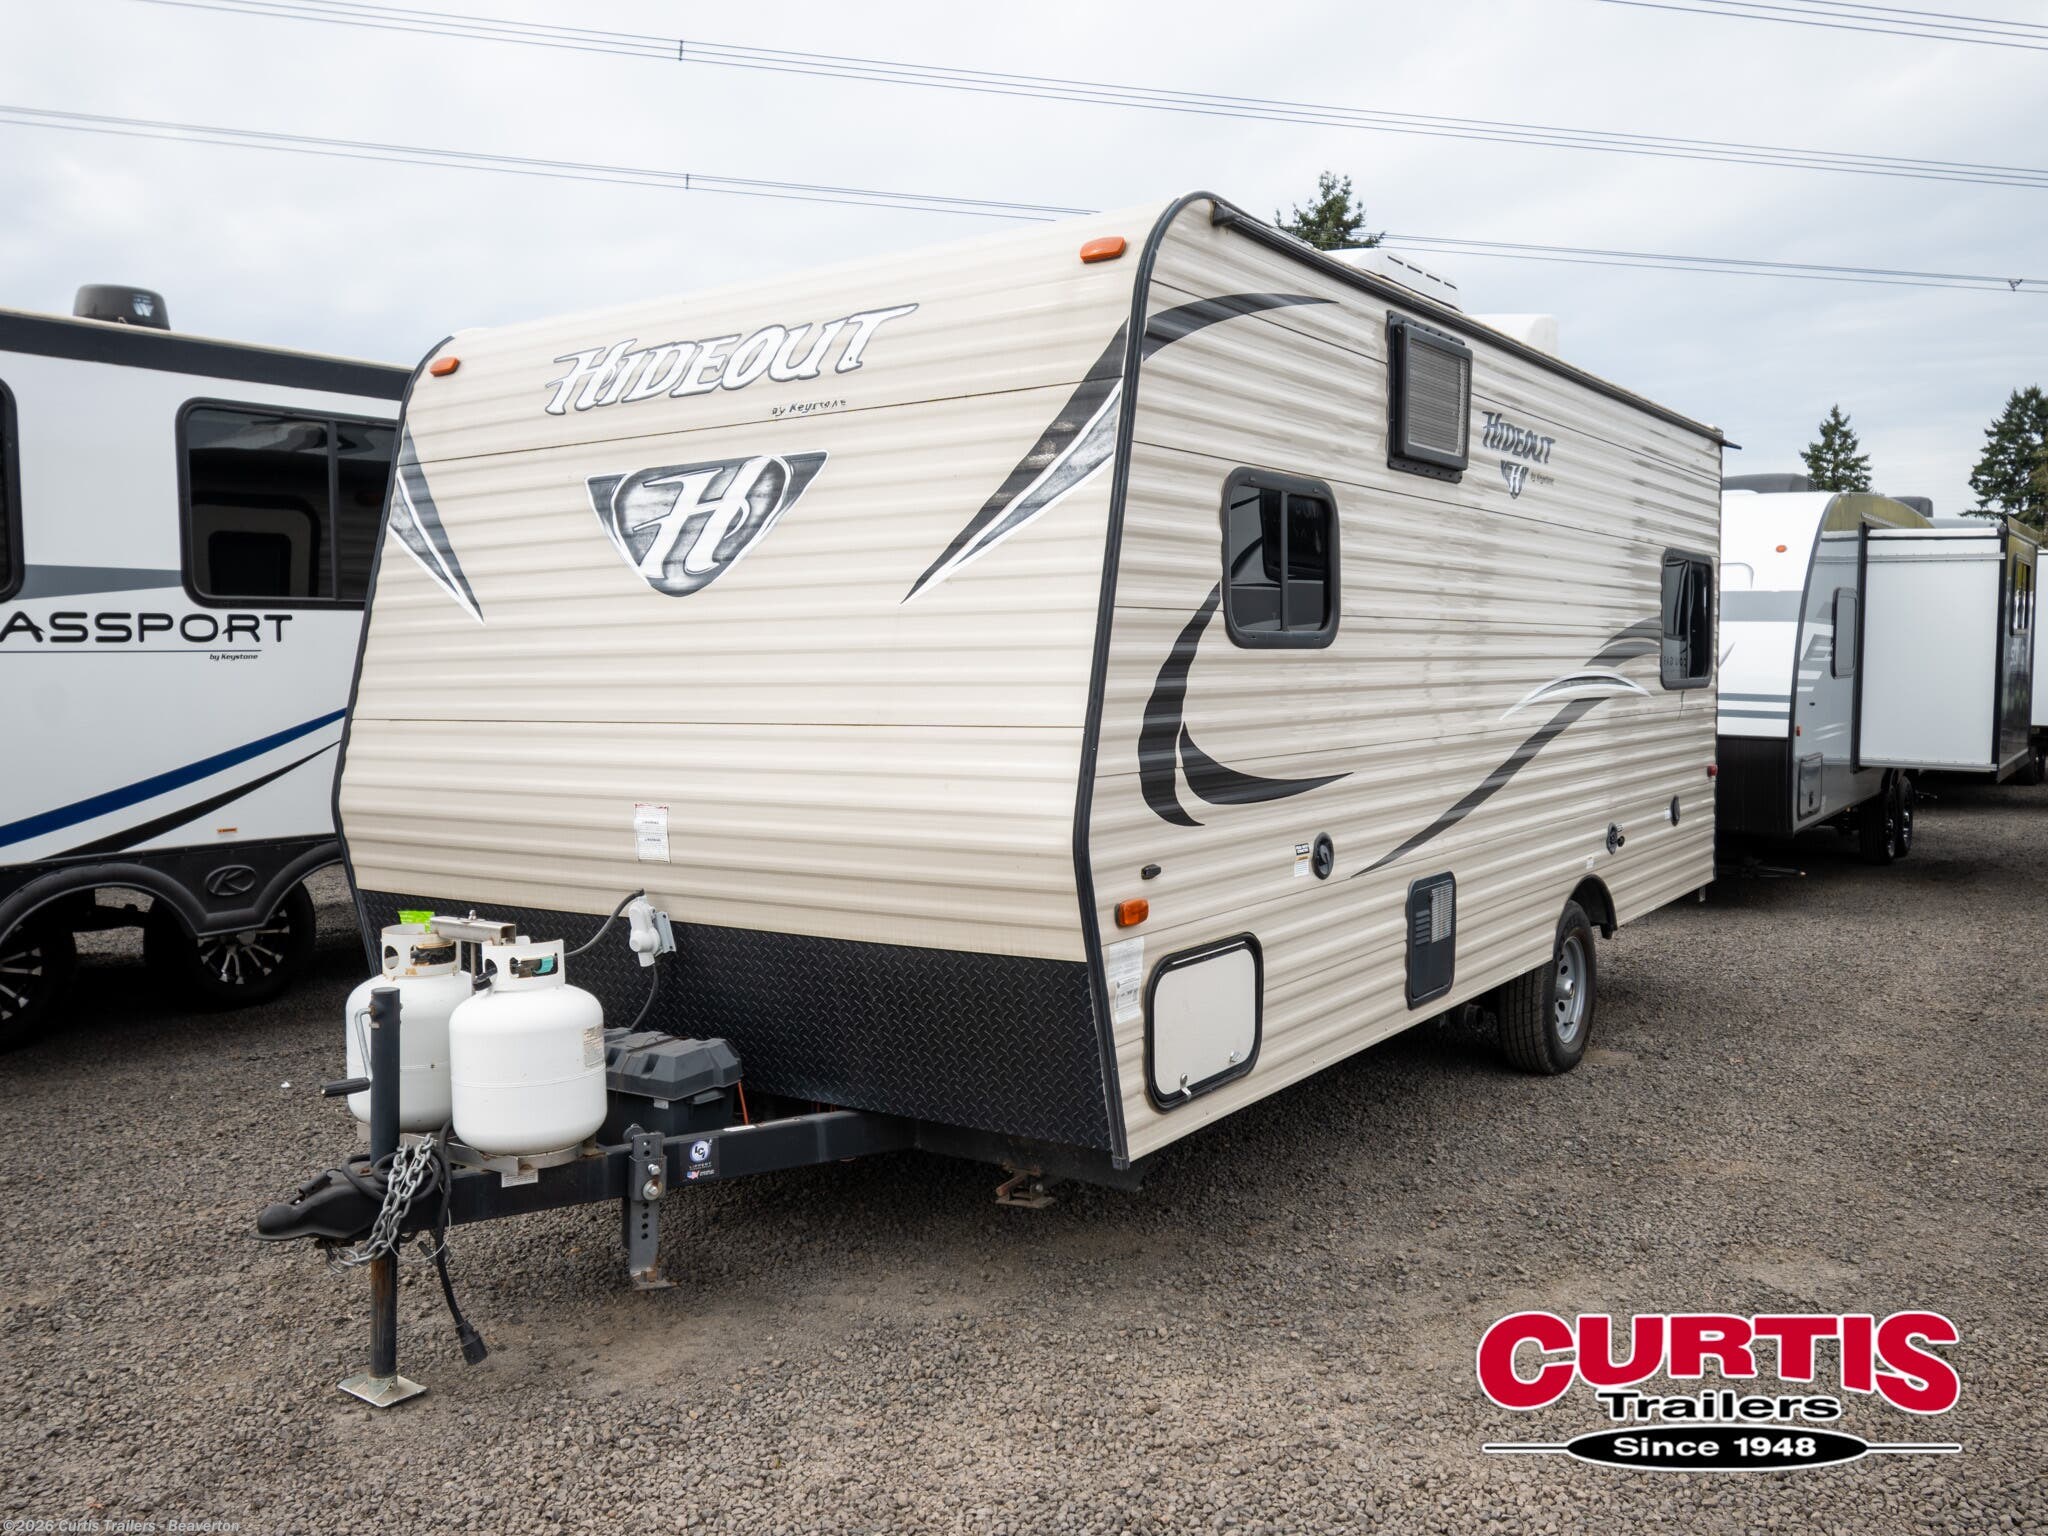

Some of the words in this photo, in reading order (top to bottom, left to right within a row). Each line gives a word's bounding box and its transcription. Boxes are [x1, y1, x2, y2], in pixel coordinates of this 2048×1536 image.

[545, 303, 919, 415] HIDEOUT
[1482, 411, 1556, 464] HIDEOUT
[0, 611, 293, 643] ASSPORT
